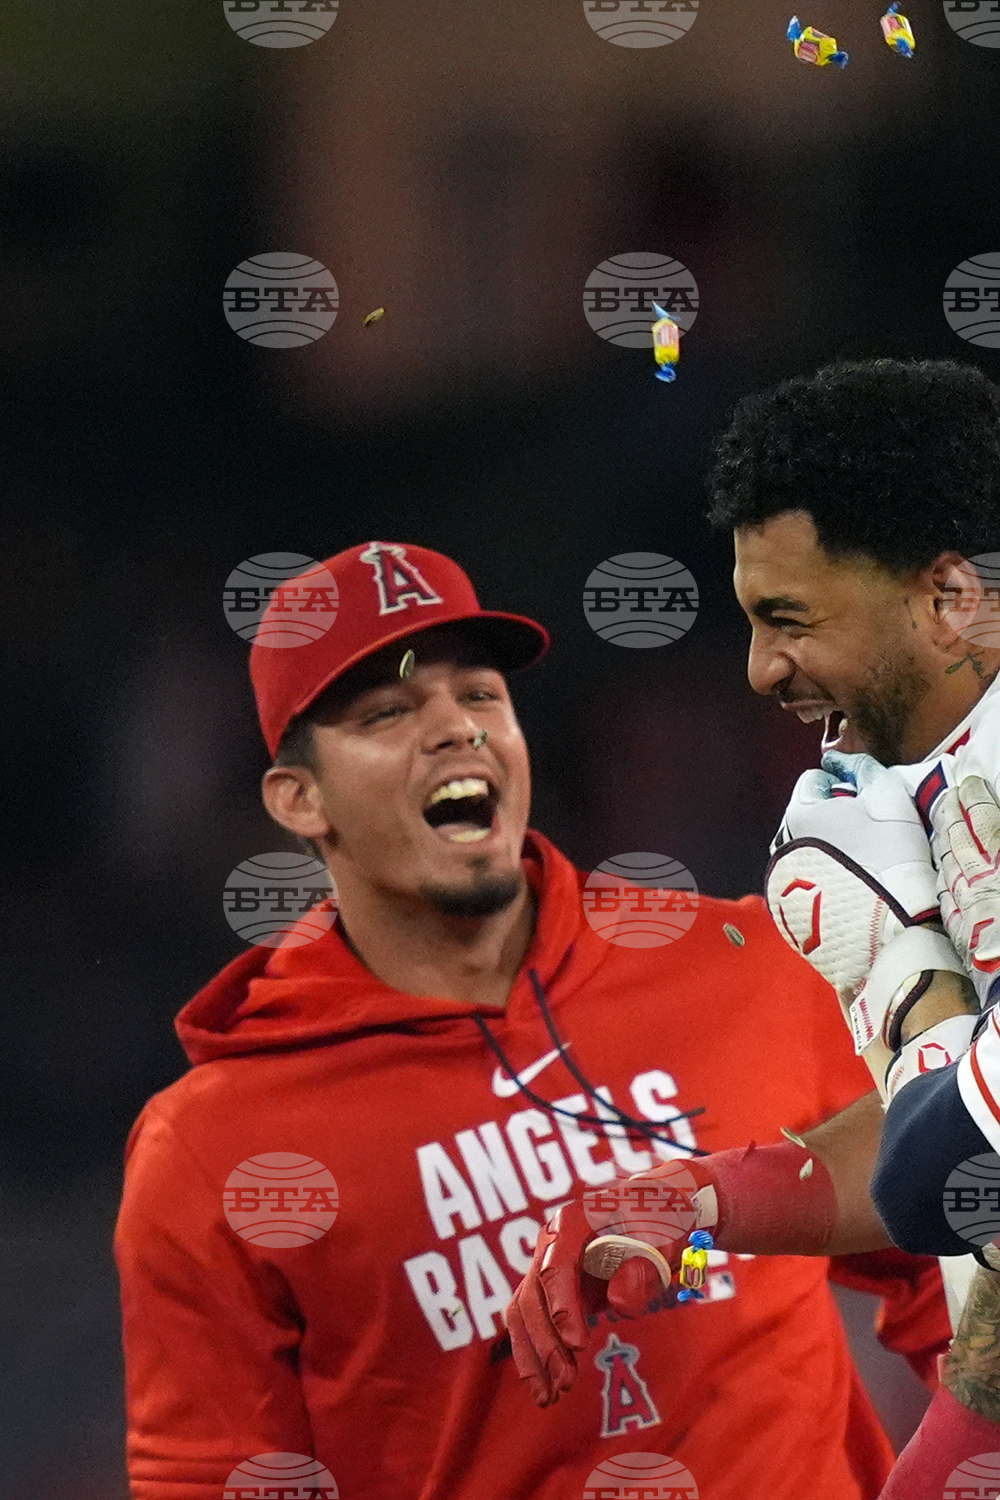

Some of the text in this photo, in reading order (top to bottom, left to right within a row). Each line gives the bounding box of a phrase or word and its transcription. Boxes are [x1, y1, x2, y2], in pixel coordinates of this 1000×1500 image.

[360, 541, 443, 615] A
[416, 1070, 697, 1239] ANGELS
[595, 1332, 661, 1438] A
